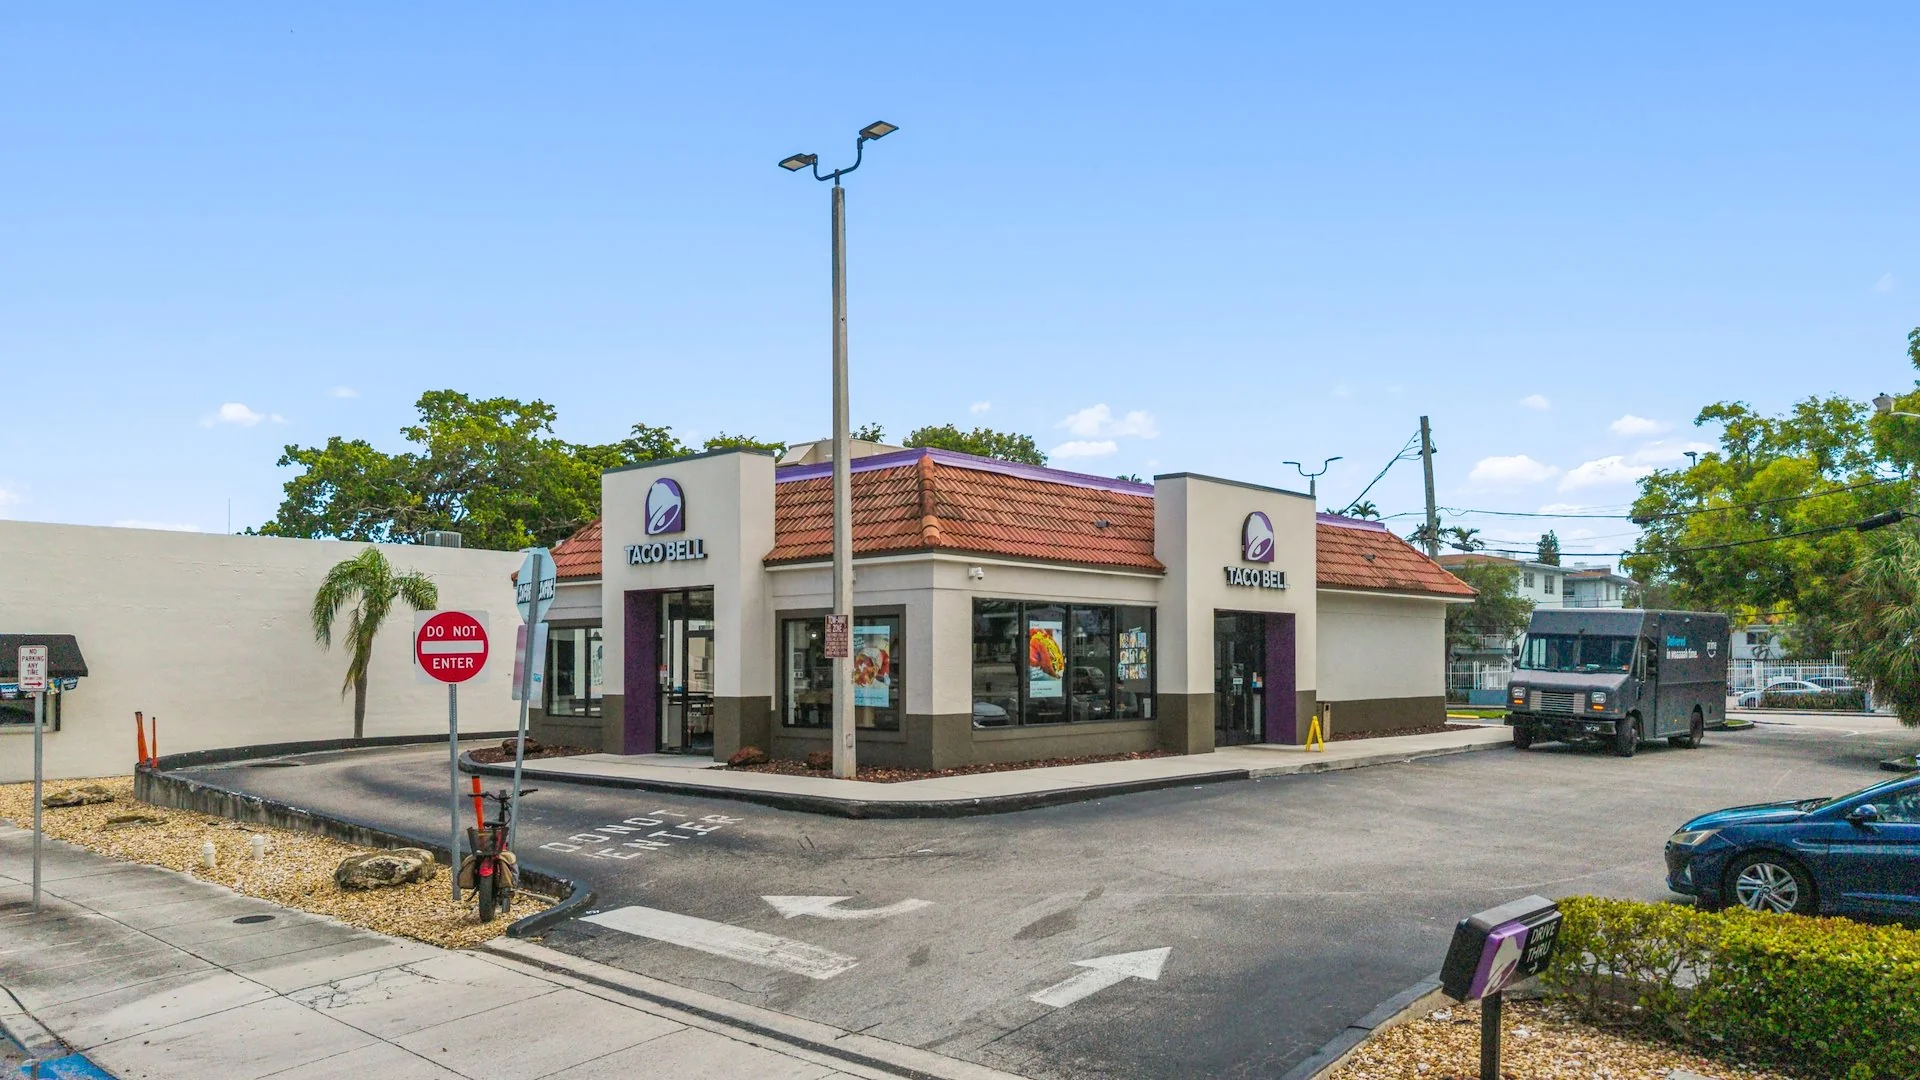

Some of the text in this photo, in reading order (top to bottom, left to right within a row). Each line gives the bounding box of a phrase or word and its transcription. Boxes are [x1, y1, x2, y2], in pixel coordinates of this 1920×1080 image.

[624, 538, 705, 565] TACO BELL
[1226, 566, 1290, 589] TACO BELL
[427, 625, 478, 638] DO NOT
[433, 657, 474, 669] ENTER
[585, 814, 745, 861] ENTER
[1530, 920, 1558, 944] DRIVE
[1526, 939, 1552, 963] THRU
